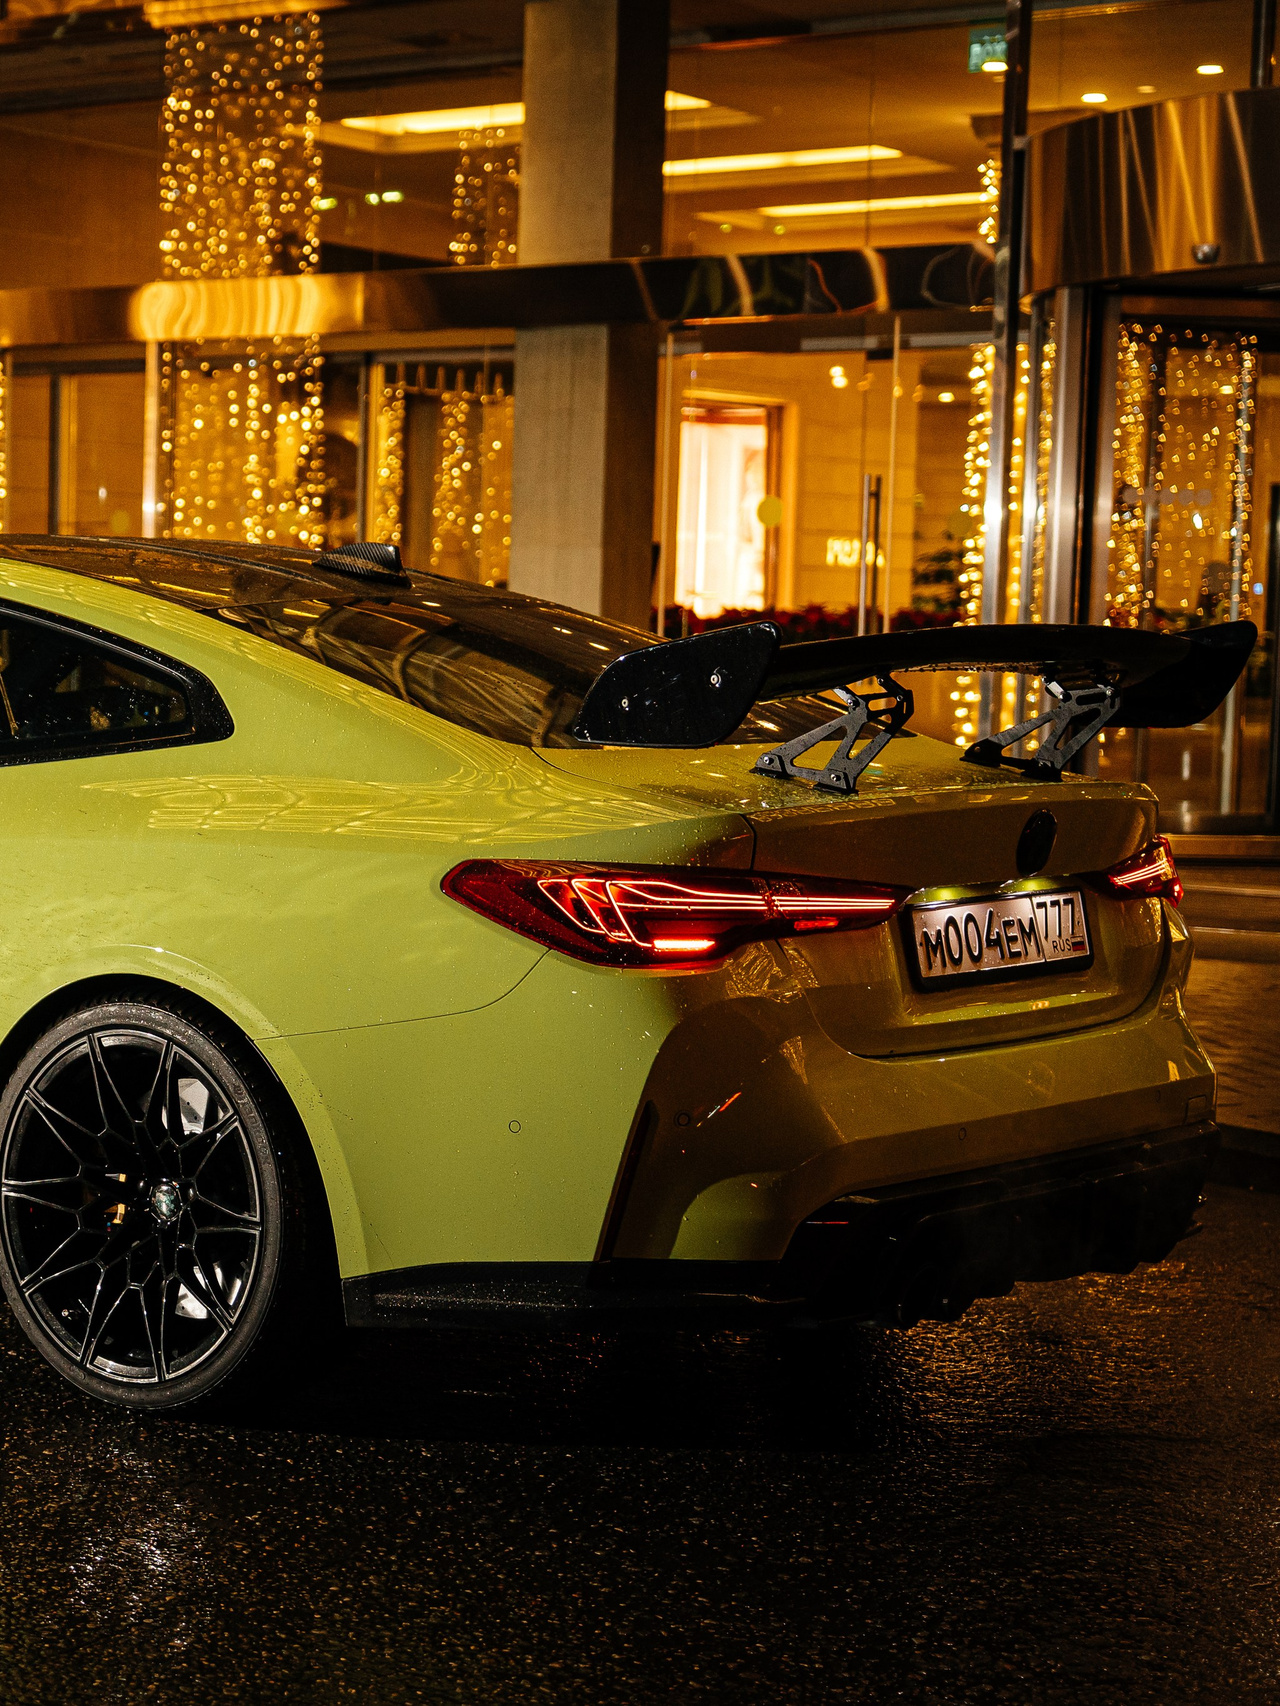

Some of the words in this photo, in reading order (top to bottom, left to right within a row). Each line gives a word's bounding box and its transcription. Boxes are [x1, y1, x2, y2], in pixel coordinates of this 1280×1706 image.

[922, 908, 1041, 970] M004EM
[1036, 897, 1074, 939] 777
[1052, 938, 1072, 954] RUS
